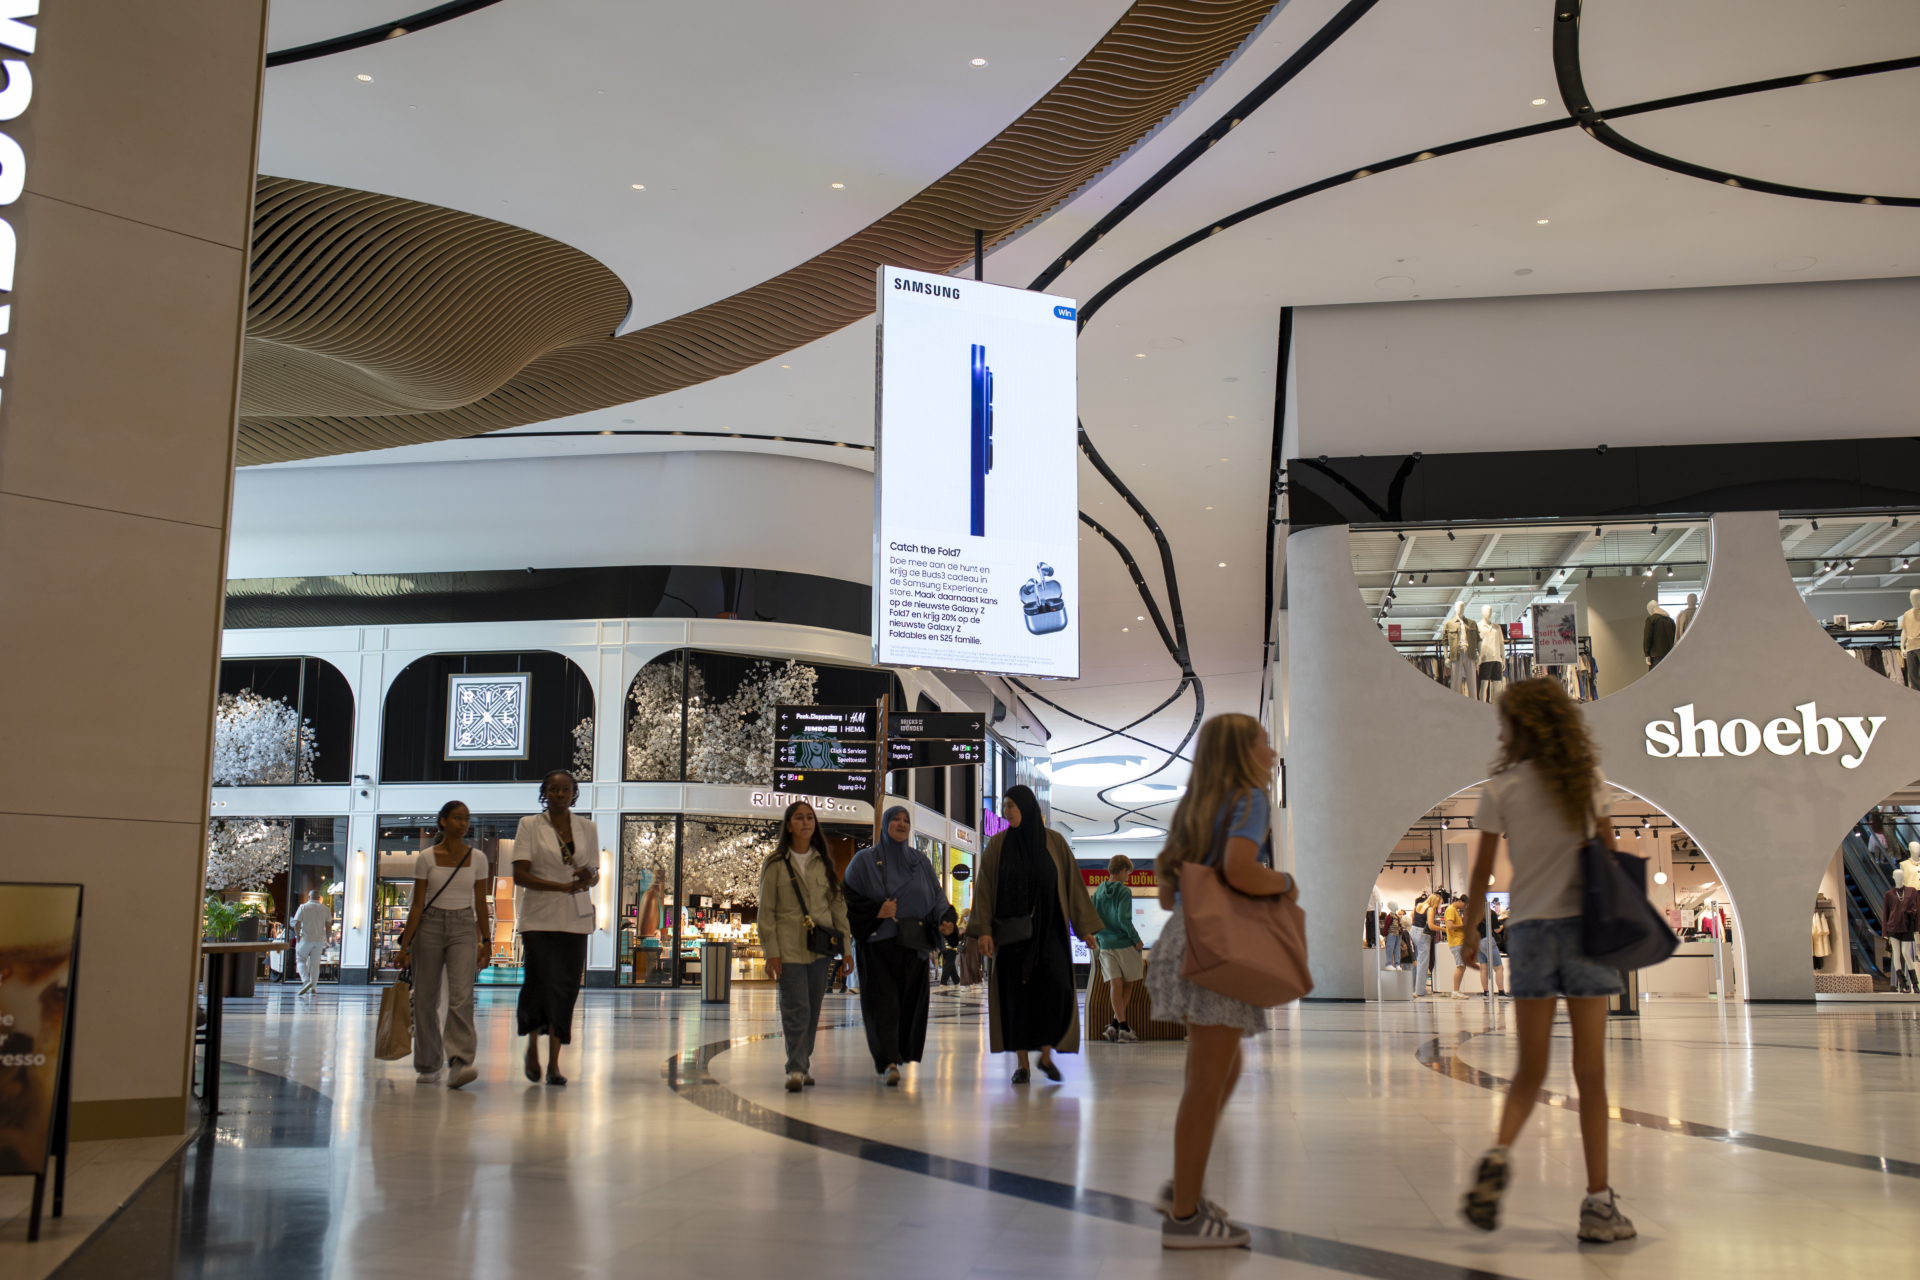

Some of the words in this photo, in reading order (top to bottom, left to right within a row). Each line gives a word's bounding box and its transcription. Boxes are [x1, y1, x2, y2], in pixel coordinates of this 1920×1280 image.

[894, 277, 960, 299] SAMSUNG
[1058, 308, 1072, 318] Win
[890, 542, 918, 553] Catch
[921, 545, 936, 555] the
[938, 547, 961, 557] Fold7
[890, 556, 907, 565] Doe
[908, 559, 928, 567] mee
[929, 562, 946, 570] aan
[947, 561, 958, 571] de
[960, 562, 979, 573] hunt
[980, 566, 990, 574] en
[890, 567, 908, 577] krijg
[909, 568, 920, 577] de
[922, 570, 946, 580] Buds3
[947, 572, 979, 583] cadeau
[980, 574, 988, 584] in
[890, 577, 901, 586] de
[902, 578, 942, 591] Samsung
[943, 583, 988, 595] Experience
[890, 588, 913, 598] store.
[915, 590, 937, 600] Maak
[938, 592, 978, 604] daarnaast
[980, 596, 998, 606] kans
[890, 600, 900, 608] op
[902, 599, 912, 608] de
[914, 600, 950, 611] nieuwste
[952, 604, 979, 615] Galaxy
[889, 609, 910, 618] Fold7
[923, 611, 940, 622] krijg
[941, 613, 956, 622] 20%
[958, 616, 969, 625] op
[970, 616, 980, 624] de
[889, 619, 926, 630] nieuwste
[927, 623, 955, 634] Galaxy
[889, 629, 927, 640] Foldables
[929, 633, 938, 641] en
[940, 634, 953, 642] S25
[954, 635, 982, 645] familie.
[1645, 701, 1887, 769] shoeby
[1131, 875, 1159, 885] WOND
